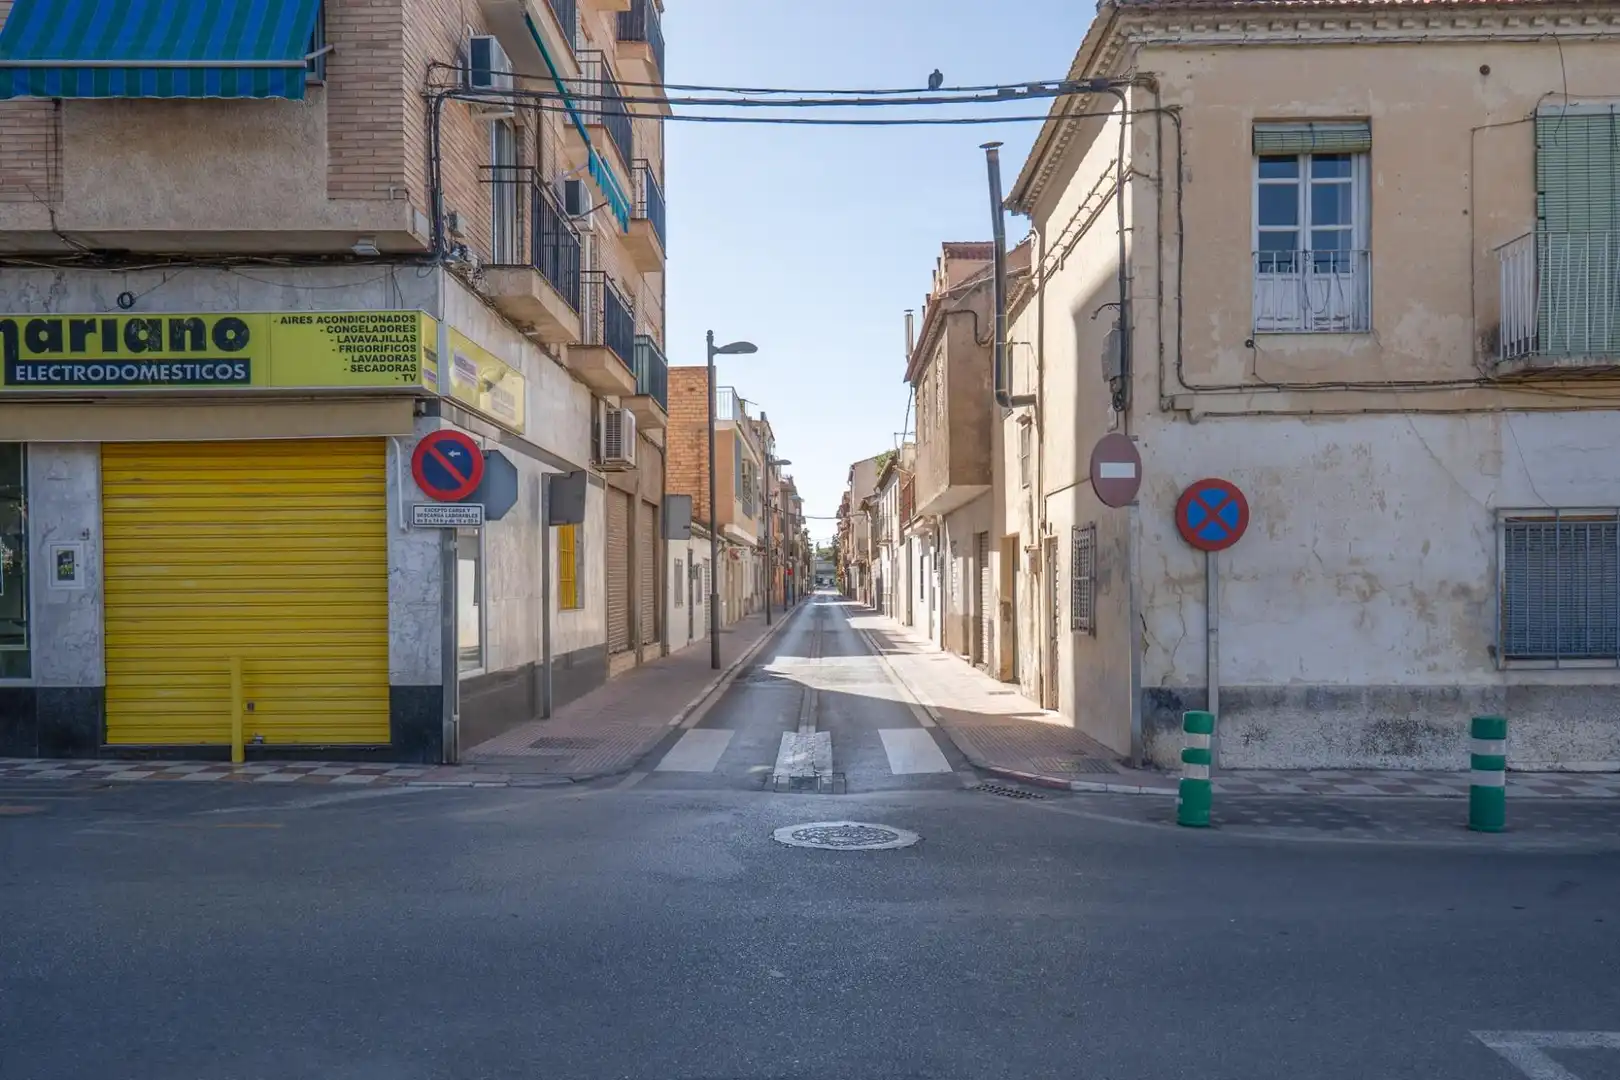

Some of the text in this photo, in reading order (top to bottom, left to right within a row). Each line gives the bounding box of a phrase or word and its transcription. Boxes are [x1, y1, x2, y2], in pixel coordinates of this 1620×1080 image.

[280, 315, 416, 324] AIRES ACONDICIONADOS
[326, 325, 416, 333] CONGELADORES
[337, 335, 416, 343] LAVAVAJILLAS
[351, 354, 416, 363] LAVADORAS
[15, 364, 246, 381] ELECTRODOMESTICOS
[350, 364, 416, 373] SECADORAS
[402, 374, 416, 382] TV
